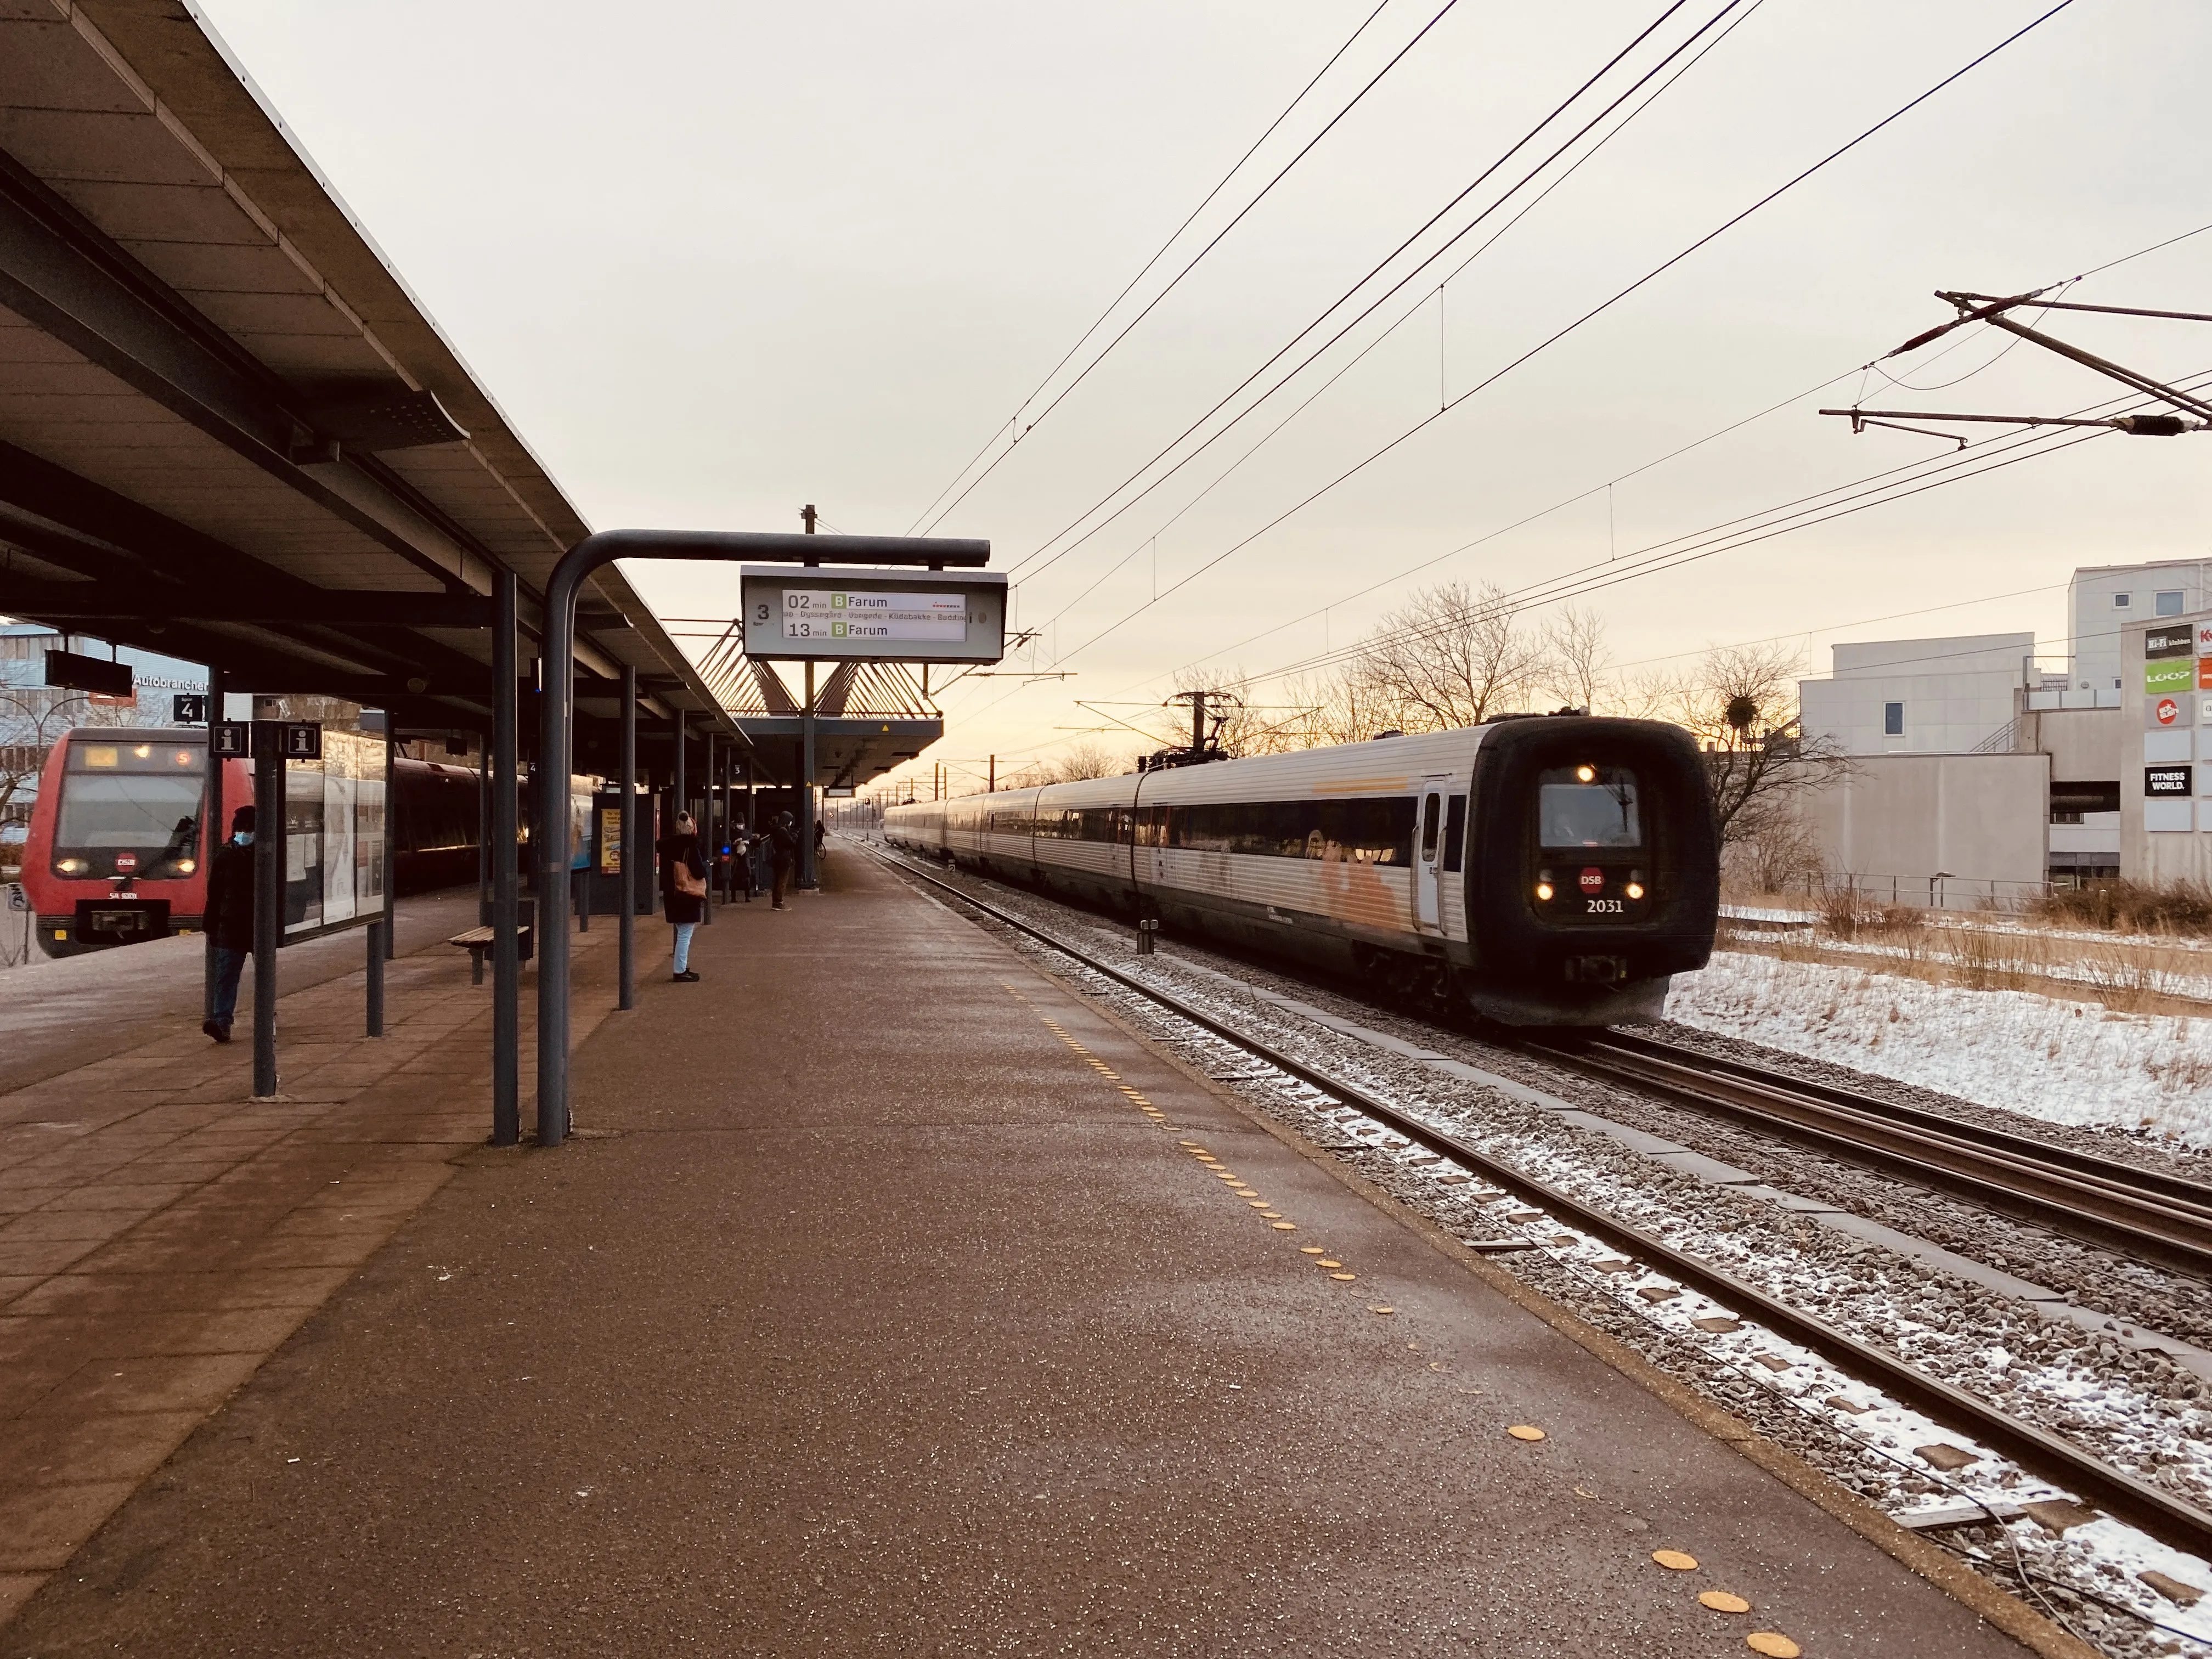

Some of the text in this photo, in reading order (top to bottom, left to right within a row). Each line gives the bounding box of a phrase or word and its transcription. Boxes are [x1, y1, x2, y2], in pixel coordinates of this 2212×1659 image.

[788, 595, 810, 609] 02
[835, 596, 844, 607] B
[849, 596, 887, 607] Farum
[758, 604, 769, 619] 3
[789, 623, 810, 637] 13
[836, 624, 844, 635] B
[849, 625, 887, 636] Farum
[2148, 638, 2167, 648] Hi-Fi
[2147, 672, 2190, 682] LOOP
[182, 703, 193, 717] 4
[2149, 772, 2185, 781] FITNESS
[1581, 876, 1602, 884] DSB
[1587, 900, 1623, 913] 2031
